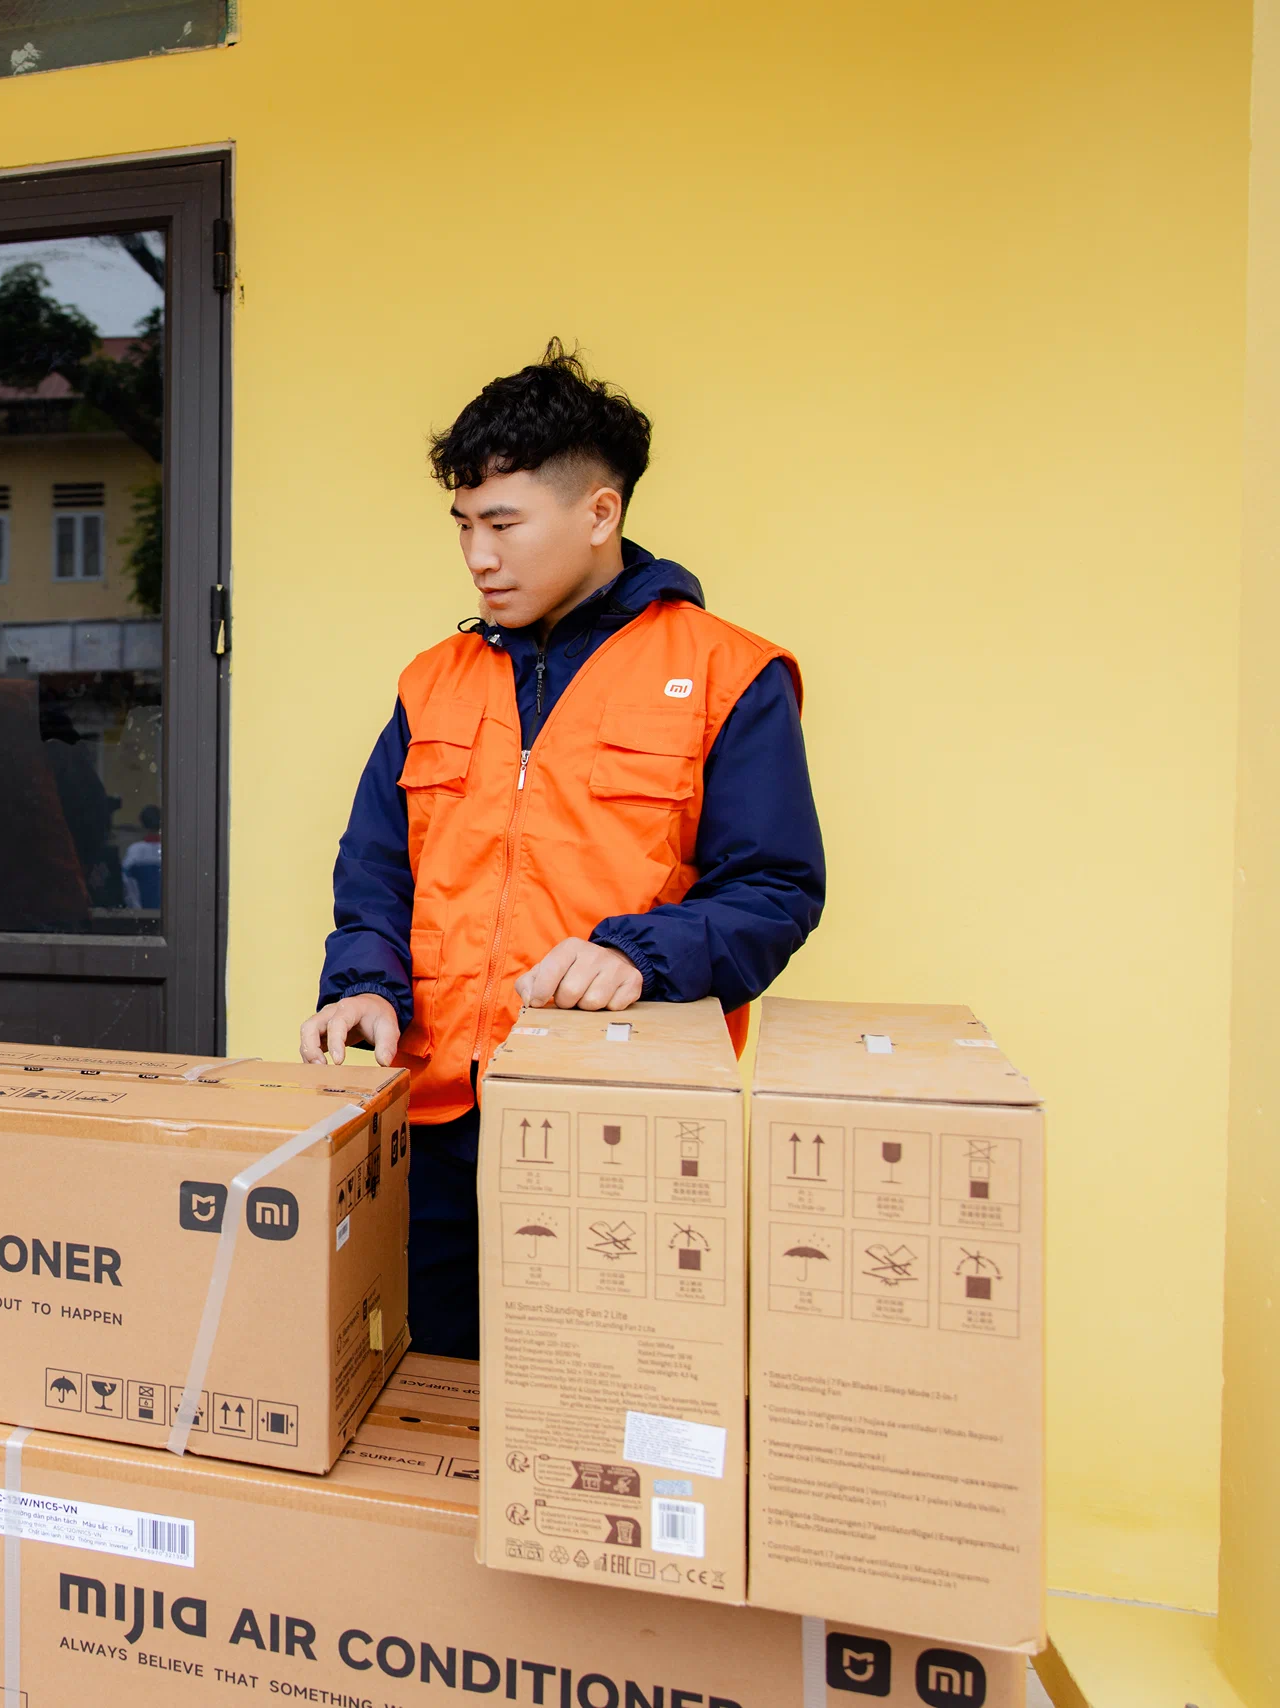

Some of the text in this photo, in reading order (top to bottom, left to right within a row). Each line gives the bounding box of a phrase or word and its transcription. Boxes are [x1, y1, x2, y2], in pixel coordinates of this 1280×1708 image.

[32, 1302, 51, 1315] TO
[62, 1306, 122, 1325] HAPPEN
[519, 1302, 543, 1313] Smart
[545, 1304, 584, 1318] Standing
[586, 1308, 601, 1317] Fan
[611, 1311, 628, 1320] Lite
[399, 1379, 459, 1392] SURFACE
[360, 1452, 426, 1467] SURFACE
[60, 1573, 743, 1708] mijia AIR CONDITION
[60, 1637, 372, 1708] ALWAYS BELIEVE THAT SOMETHING
